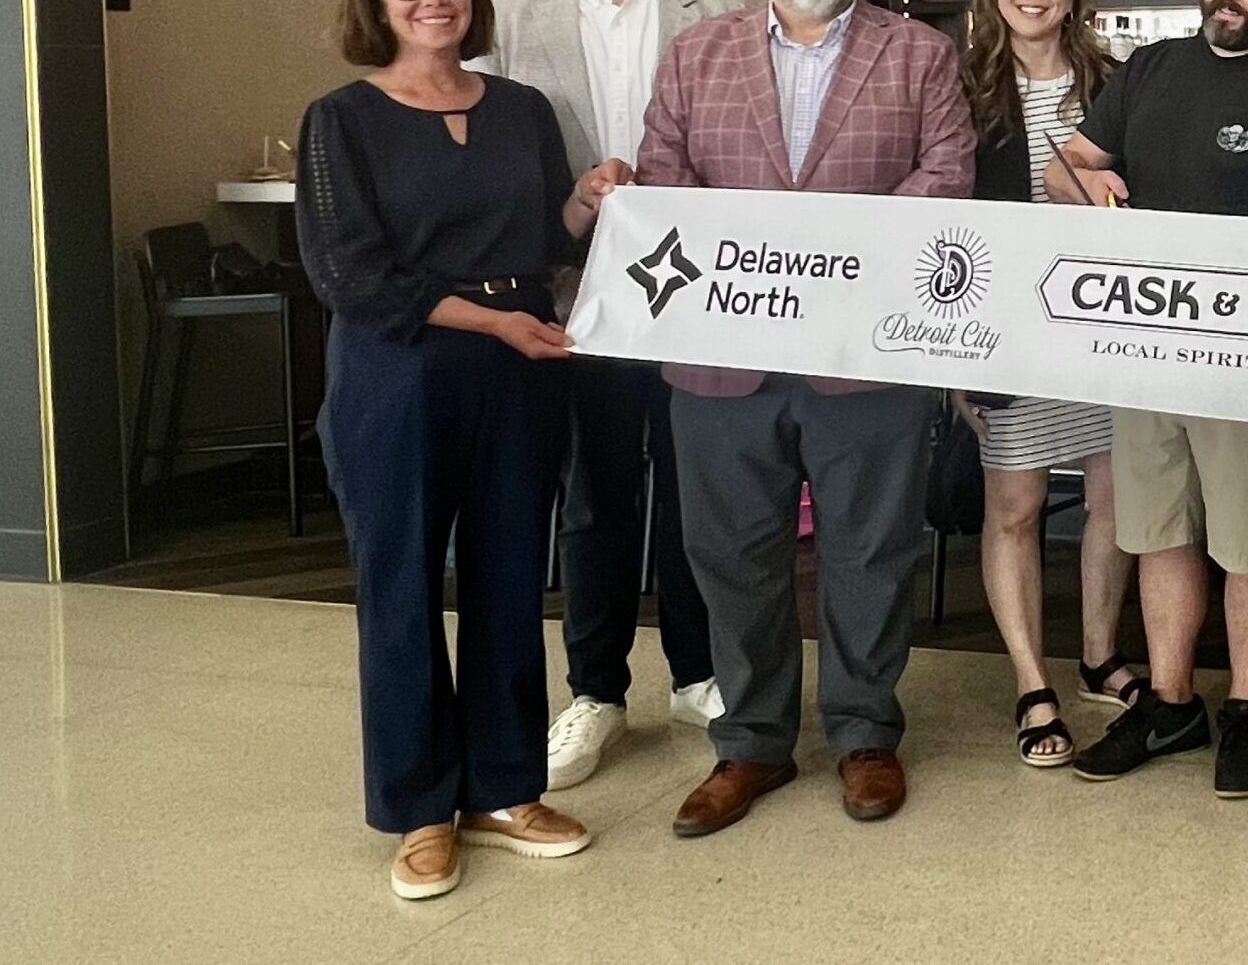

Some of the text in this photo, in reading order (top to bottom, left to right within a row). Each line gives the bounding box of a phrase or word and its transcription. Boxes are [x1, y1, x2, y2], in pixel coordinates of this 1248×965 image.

[714, 240, 861, 280] Delaware
[1072, 272, 1199, 320] CASK
[1213, 291, 1240, 316] &
[878, 312, 1001, 360] Detroit City
[1092, 339, 1167, 361] LOCAL
